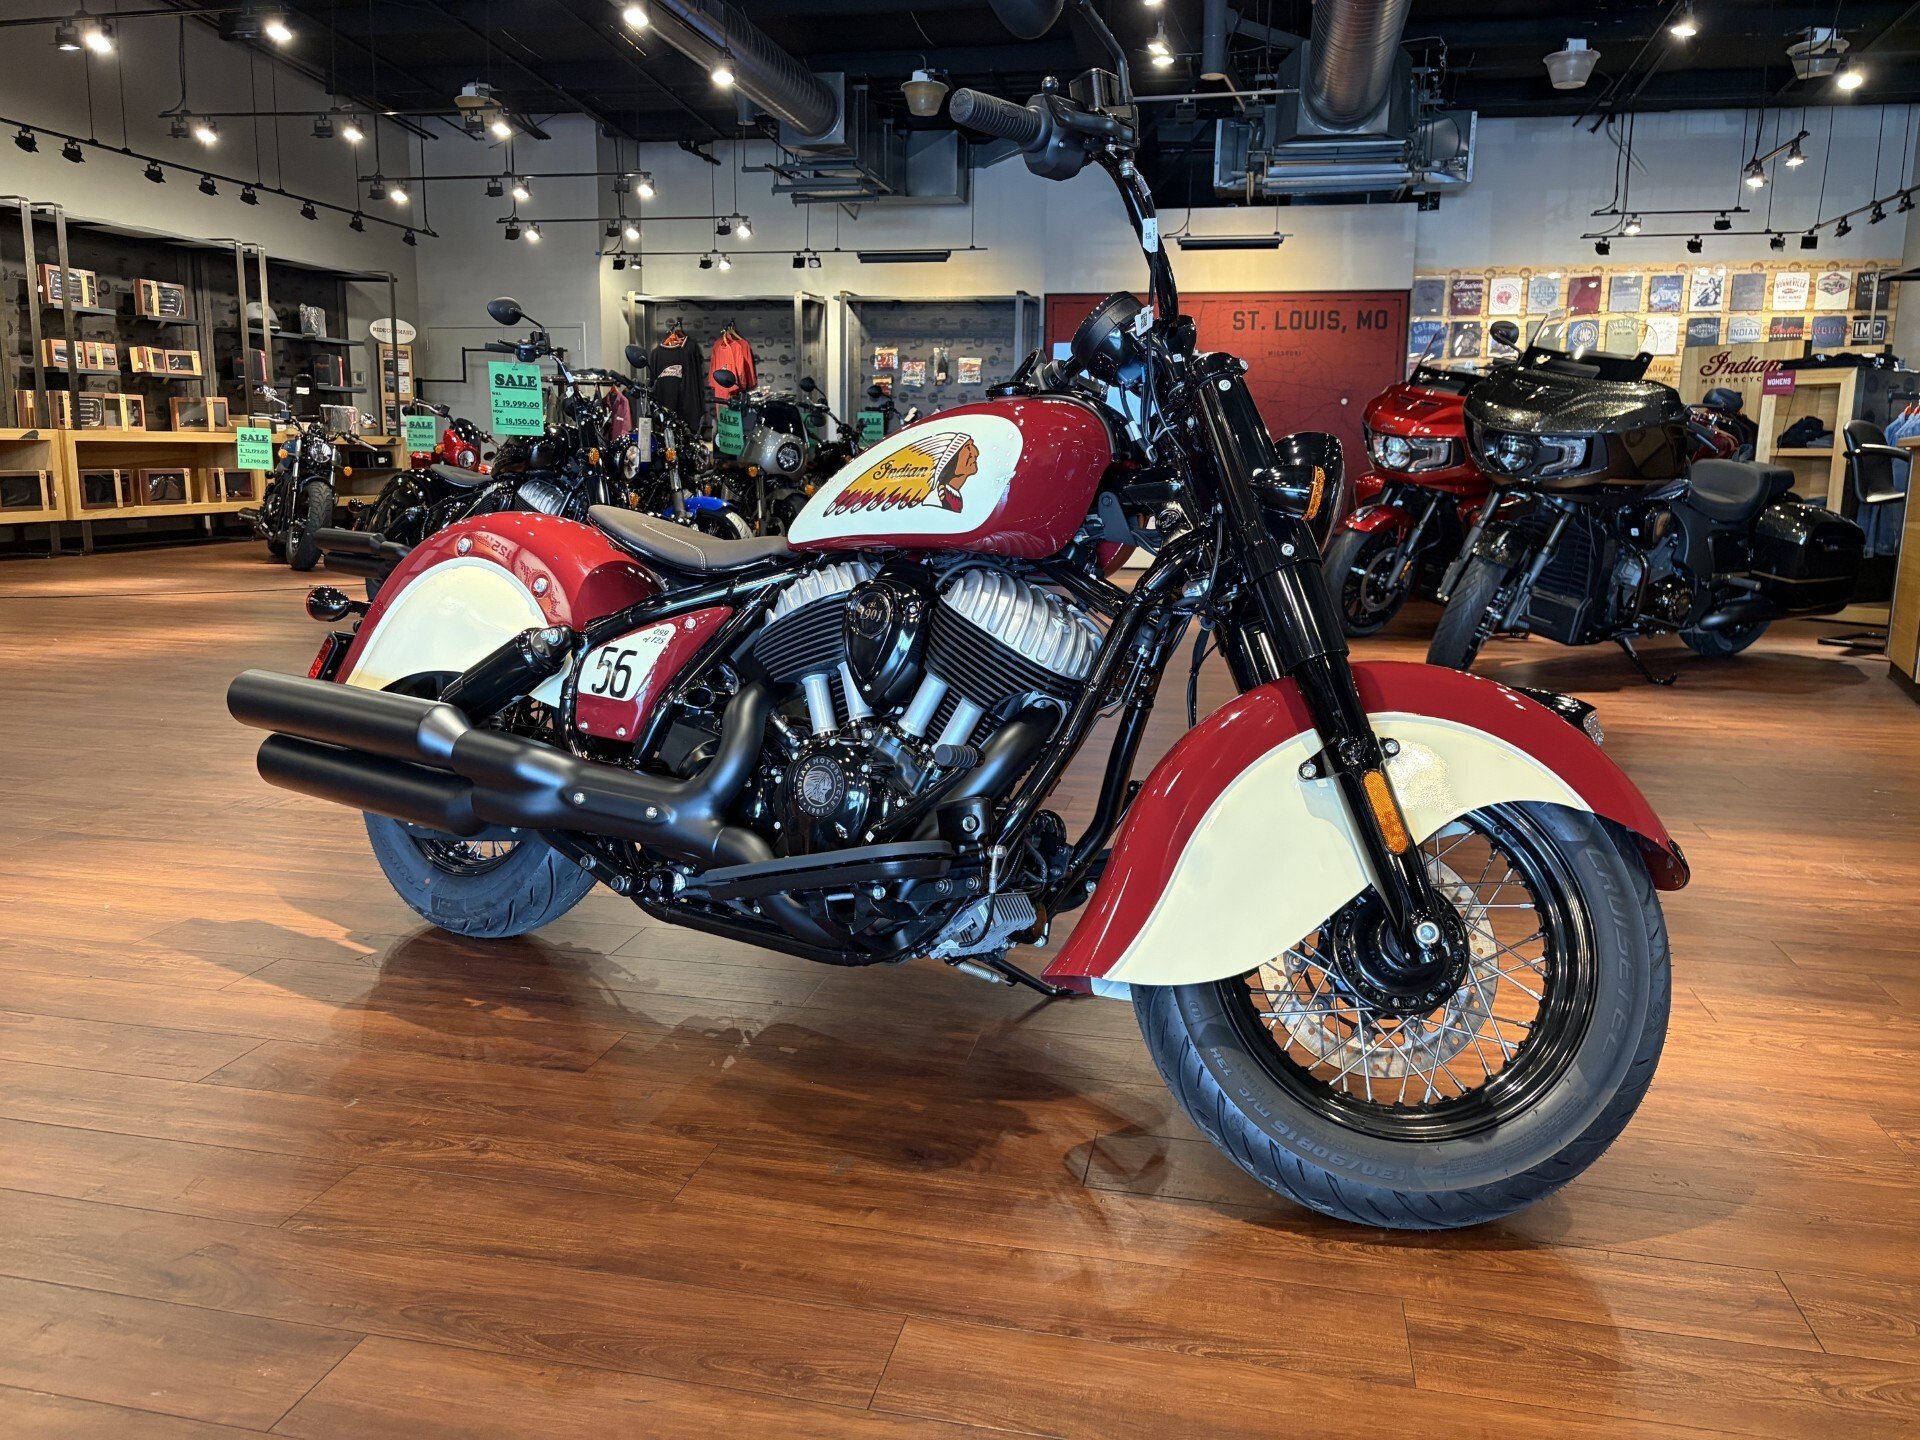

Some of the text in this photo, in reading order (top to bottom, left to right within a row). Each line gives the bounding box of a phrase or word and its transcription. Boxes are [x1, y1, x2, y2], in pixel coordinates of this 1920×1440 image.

[1233, 310, 1389, 333] ST. LOUIS, MO
[1731, 328, 1760, 336] INDIAN
[1855, 322, 1882, 335] IMC
[1700, 351, 1782, 377] Indian
[495, 373, 537, 387] SALE
[1701, 376, 1762, 384] MOTORCYC
[1767, 378, 1792, 386] WOMENS
[502, 400, 540, 408] 19,999.00
[409, 421, 433, 429] SALE
[506, 418, 540, 426] 18,150.00
[720, 413, 739, 424] SALE
[240, 433, 269, 441] SALE
[872, 459, 927, 480] Indian
[860, 609, 882, 622] 1901
[592, 646, 637, 699] 56
[797, 763, 811, 800] INDIAN
[1585, 848, 1637, 1053] CRUISETEC
